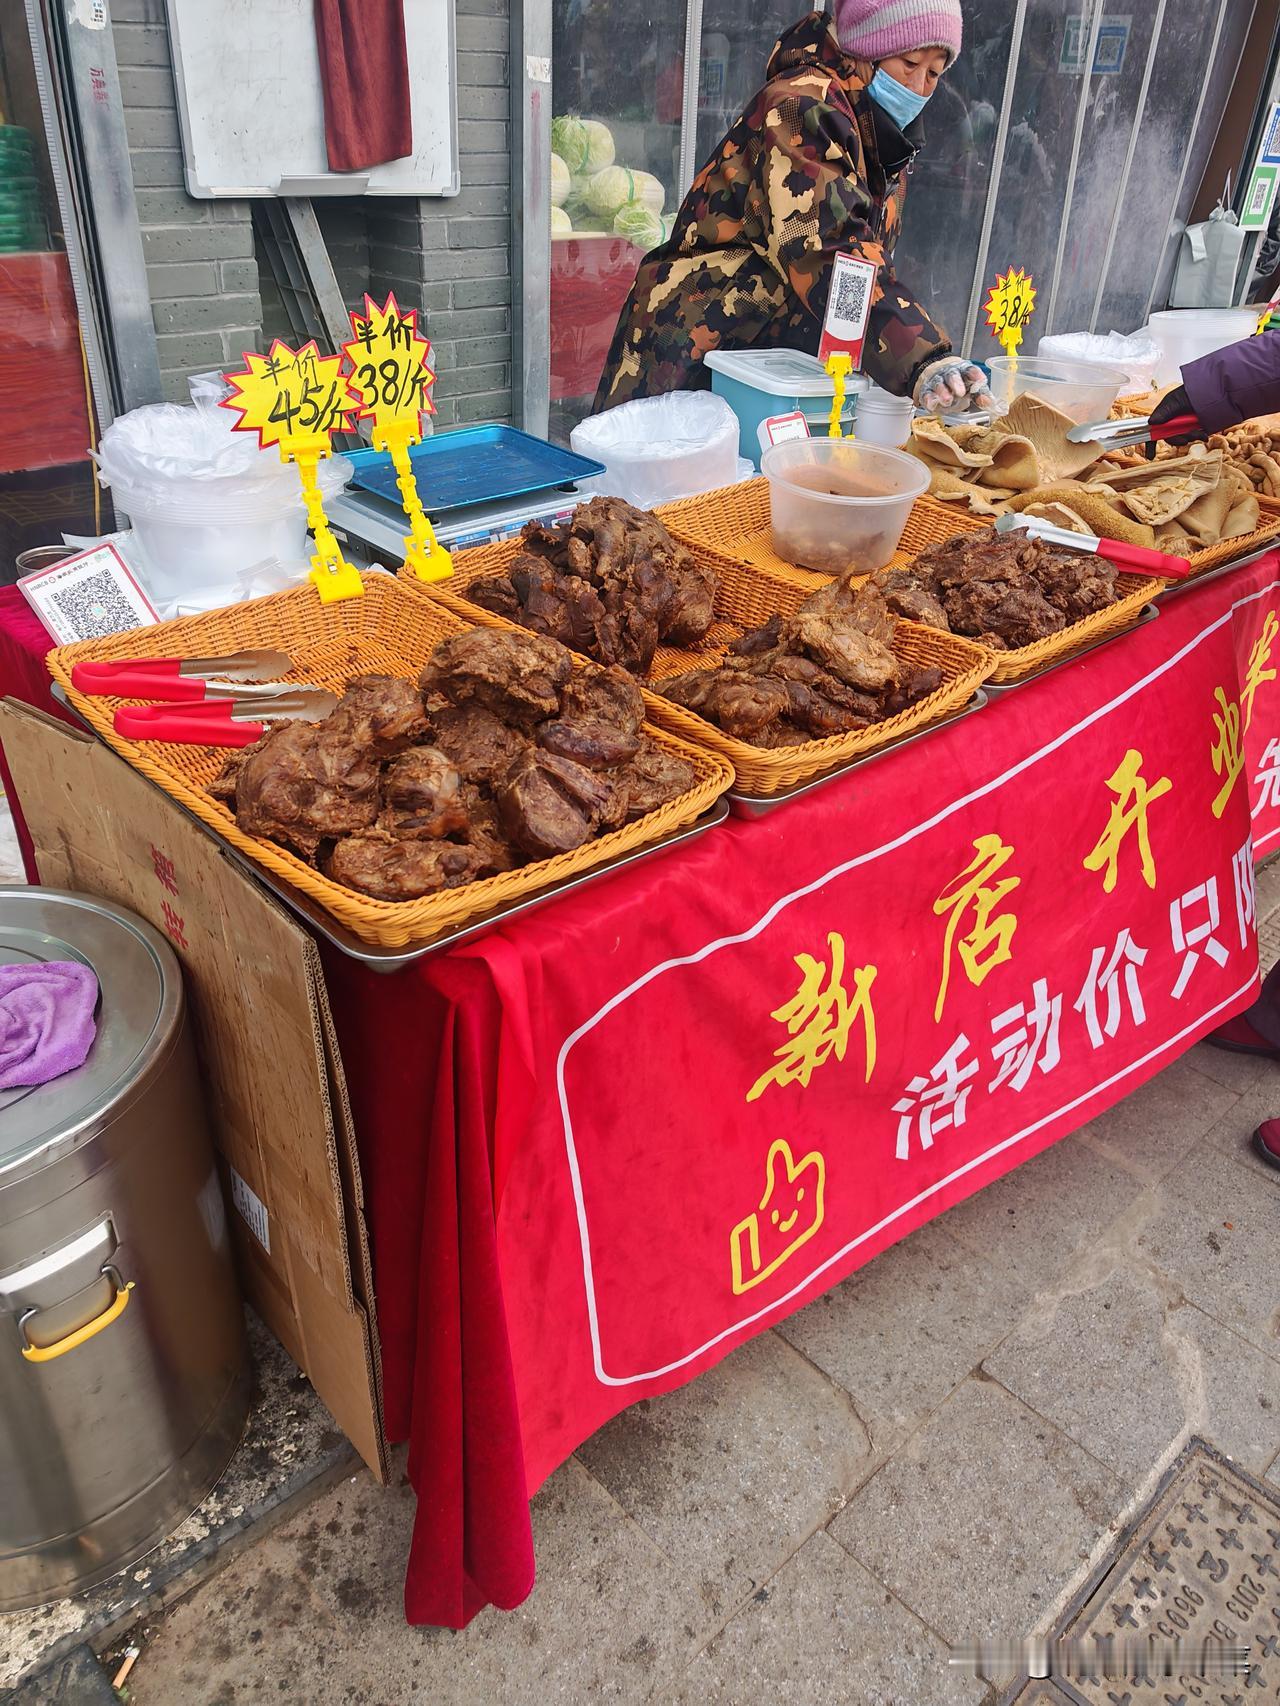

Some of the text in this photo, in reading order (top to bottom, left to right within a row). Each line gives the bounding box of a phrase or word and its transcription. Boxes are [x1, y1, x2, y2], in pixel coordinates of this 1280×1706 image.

[357, 314, 414, 355] 半价
[261, 350, 320, 388] 半价
[357, 358, 428, 416] 38/斤
[267, 377, 348, 435] 45/斤
[746, 686, 1246, 1103] 新店开业
[1225, 1573, 1266, 1621] 2013
